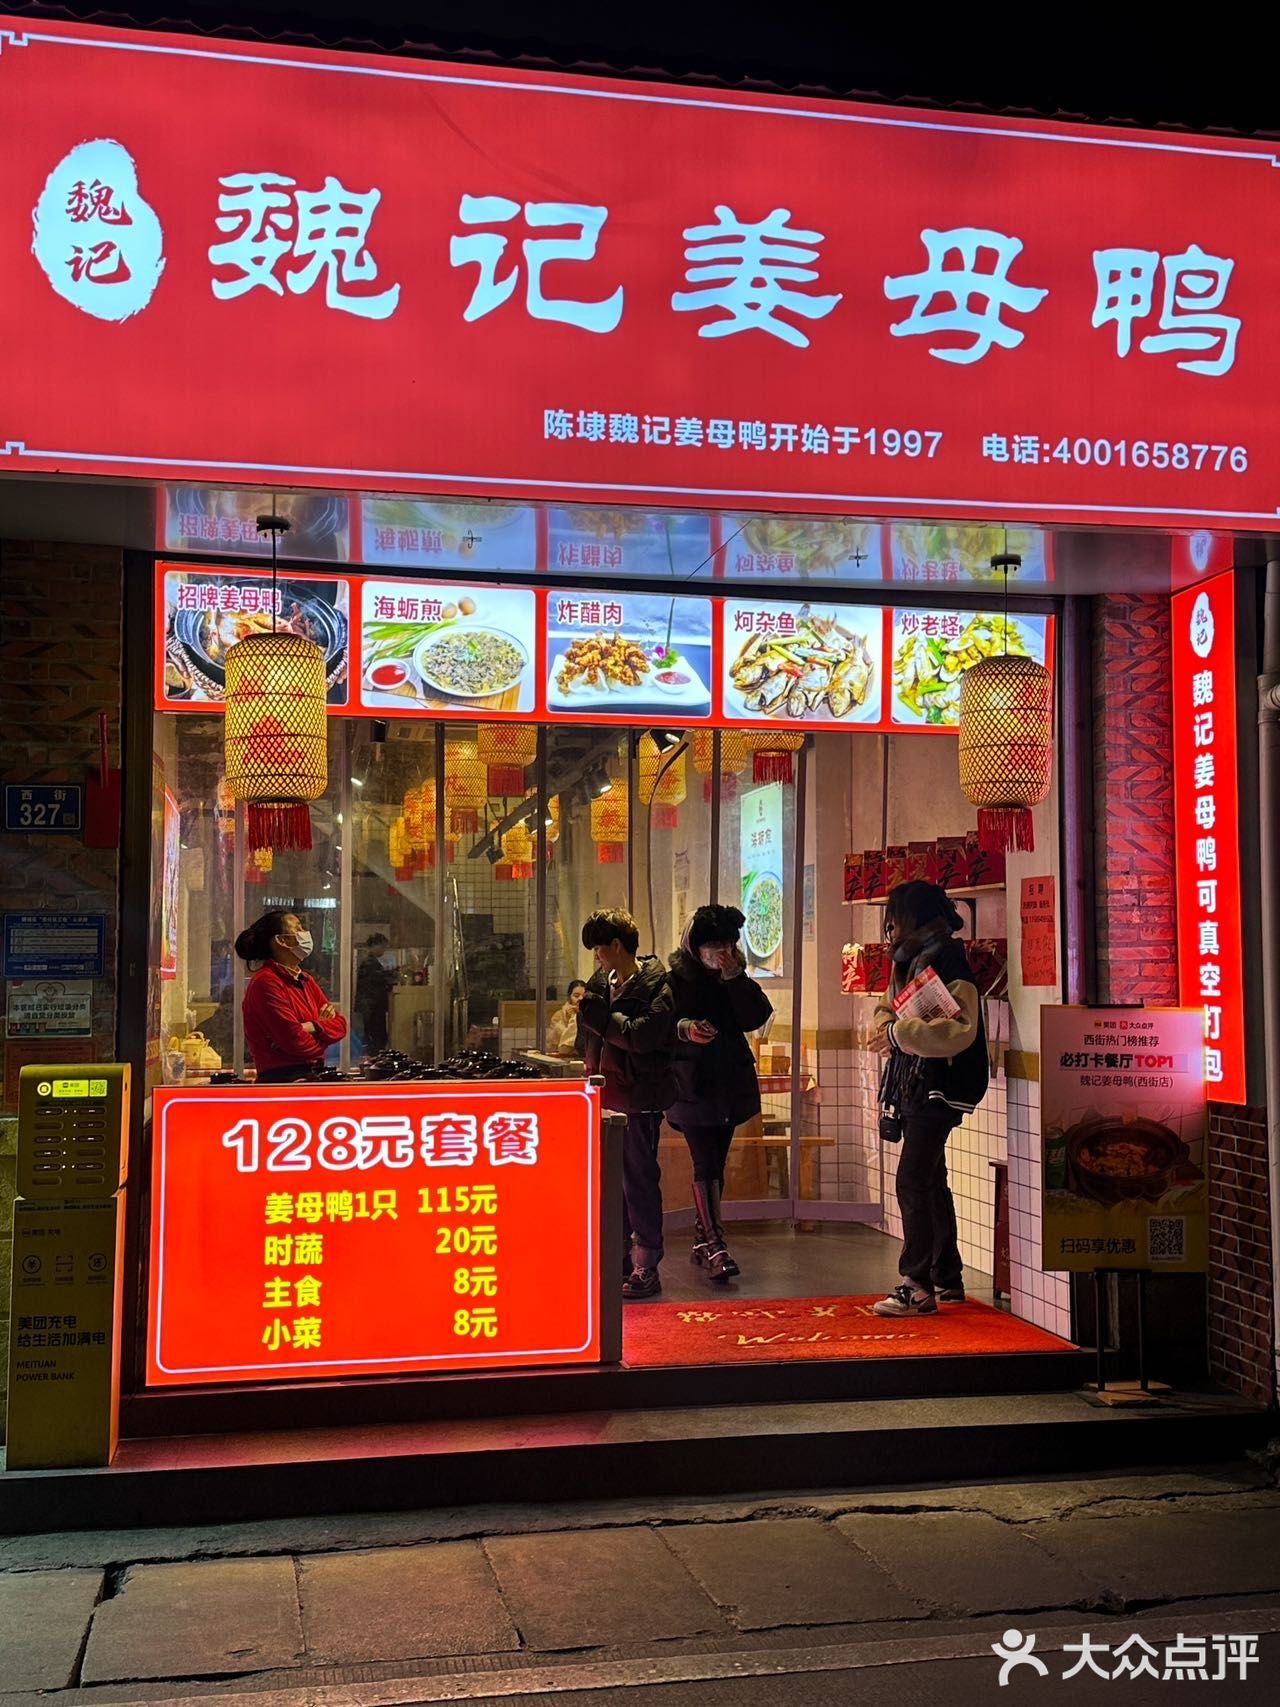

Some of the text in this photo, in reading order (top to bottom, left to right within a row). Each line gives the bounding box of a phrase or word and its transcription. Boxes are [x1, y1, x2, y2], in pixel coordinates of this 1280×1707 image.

[65, 178, 133, 285] 魏记
[207, 171, 1242, 377] 魏记姜母鸭
[543, 408, 1250, 473] 陈埭魏记姜母鸭开始于1997 电话:4001658776
[177, 584, 283, 615] 招牌姜母鸭
[372, 594, 444, 622] 海蛎煎
[556, 599, 624, 627] 炸醋肉
[20, 789, 67, 801] 西街
[19, 803, 61, 826] 327
[1191, 668, 1224, 1083] 魏记姜母鸭可真空打包
[1083, 1034, 1160, 1048] 西街热门榜推荐
[222, 1111, 539, 1173] 128元套餐
[264, 1183, 498, 1225] 姜母鸭1只 115元
[263, 1225, 498, 1266] 时蔬 20元
[1060, 1237, 1137, 1255] 扫码享优惠
[262, 1266, 498, 1309] 主食 8元
[17, 1315, 78, 1330] 美团充电
[261, 1308, 498, 1351] 小菜 8元
[16, 1332, 106, 1348] 给生活加满电
[16, 1360, 57, 1369] MEITUAN
[16, 1371, 76, 1382] POWER BANK
